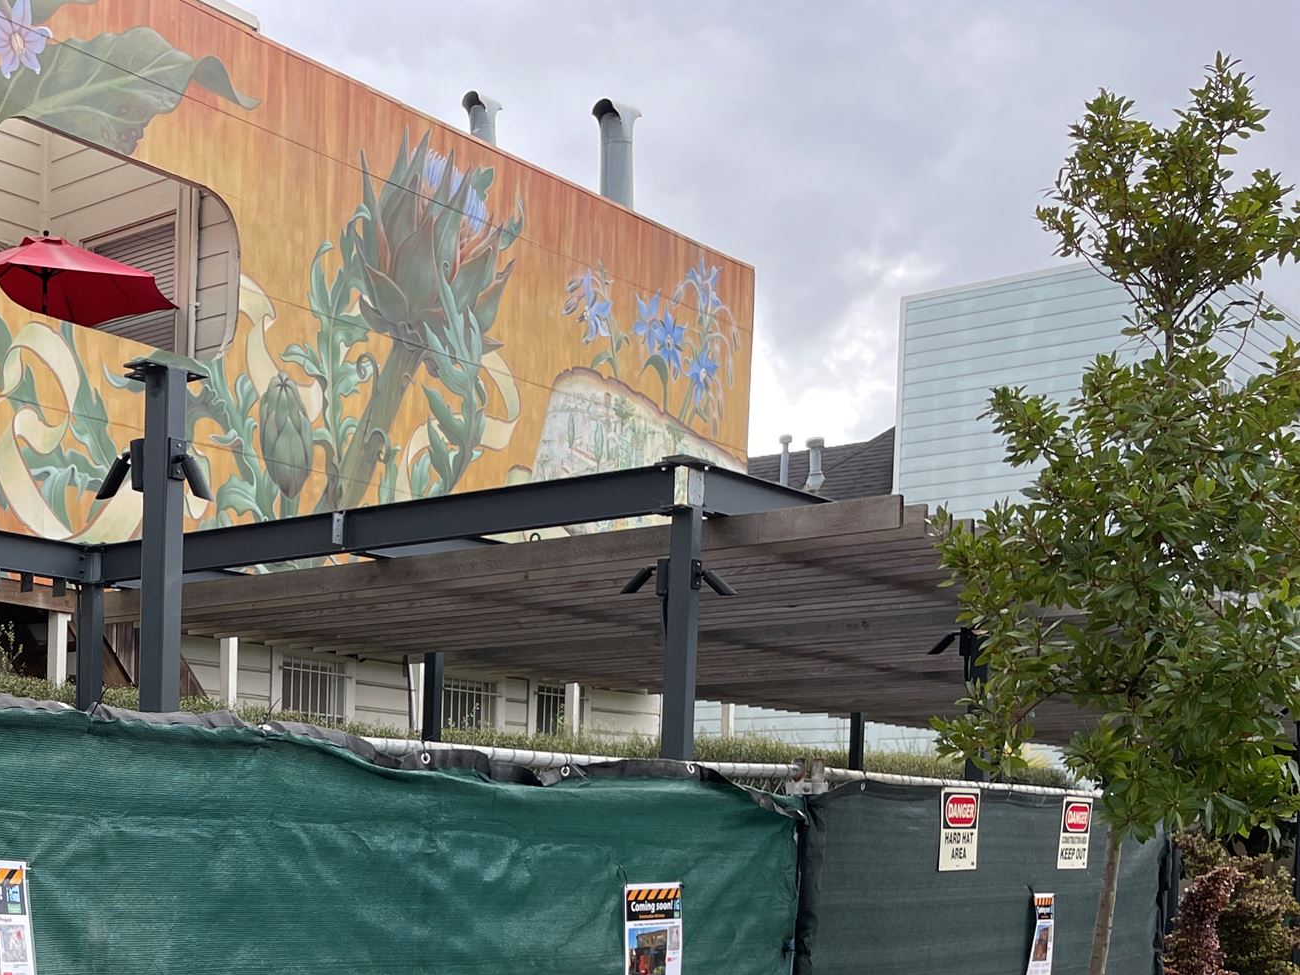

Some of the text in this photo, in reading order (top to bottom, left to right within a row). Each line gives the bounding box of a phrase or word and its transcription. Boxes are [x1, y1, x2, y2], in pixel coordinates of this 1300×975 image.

[948, 803, 974, 818] DANGER
[1068, 810, 1088, 824] DANGER
[944, 832, 974, 844] HARD HAT
[950, 847, 966, 860] AREA
[1060, 848, 1086, 860] KEEP OUT
[630, 900, 673, 914] Coming soon!
